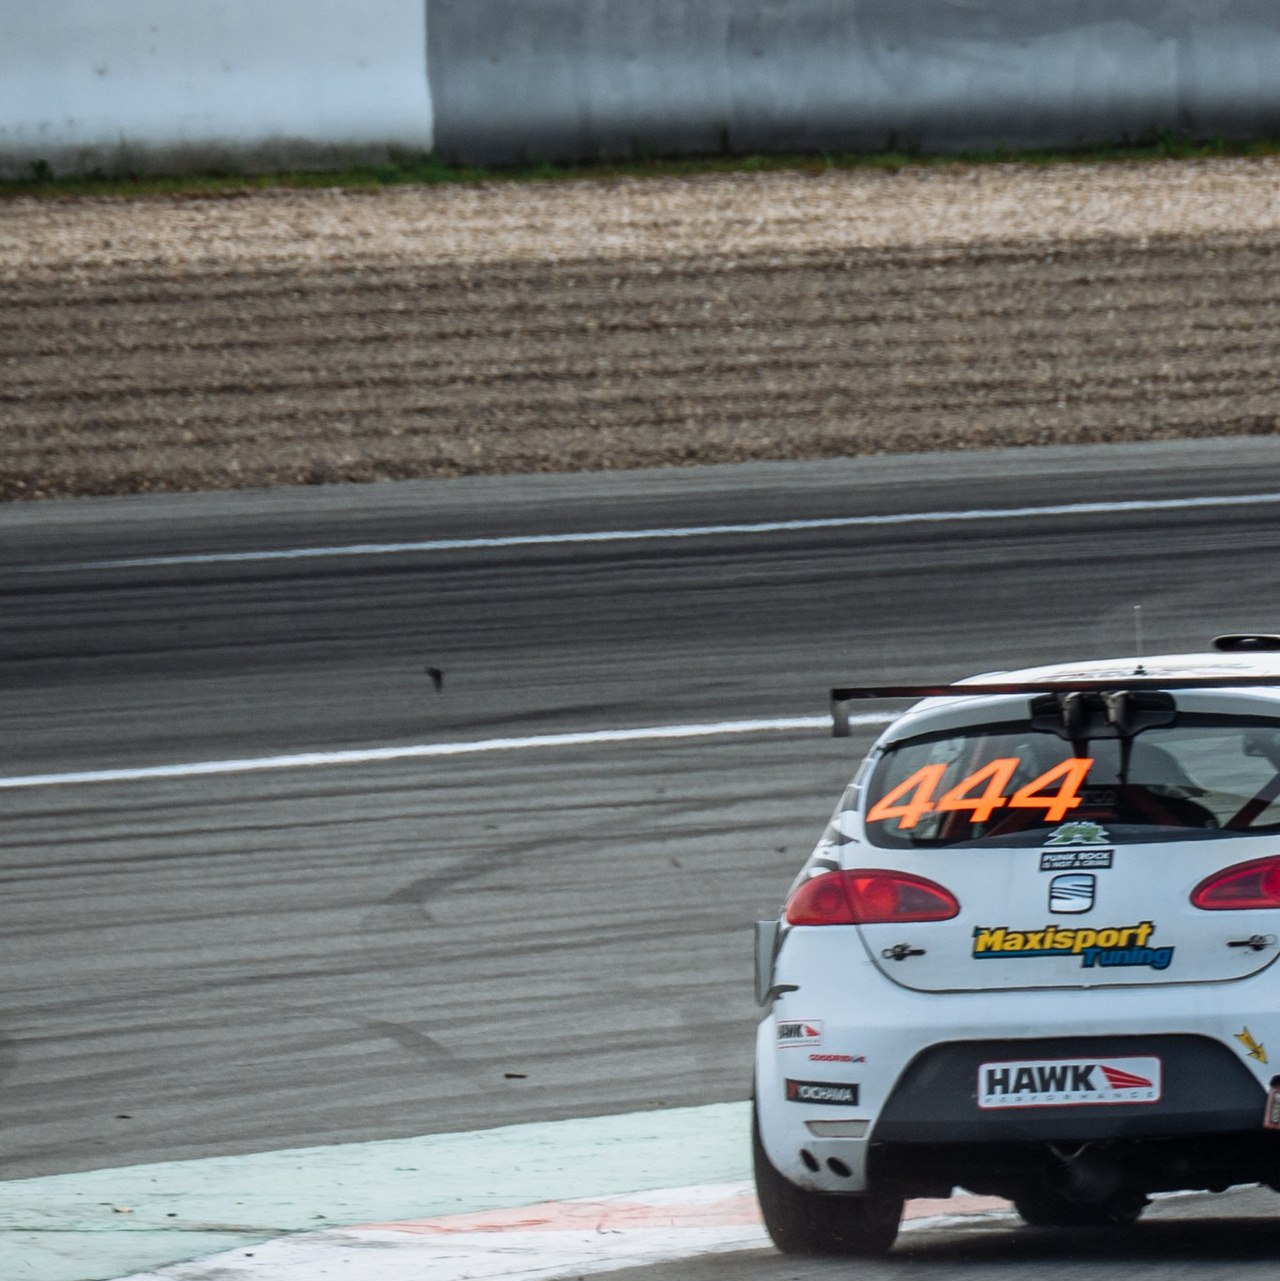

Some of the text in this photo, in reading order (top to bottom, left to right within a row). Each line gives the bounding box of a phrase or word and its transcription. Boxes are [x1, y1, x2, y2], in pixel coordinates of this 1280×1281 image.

[866, 758, 1095, 829] 444
[1043, 852, 1111, 861] PUNK ROCK
[973, 921, 1154, 955] Maxisport
[1083, 948, 1174, 969] Tuning
[986, 1064, 1098, 1096] HAWK
